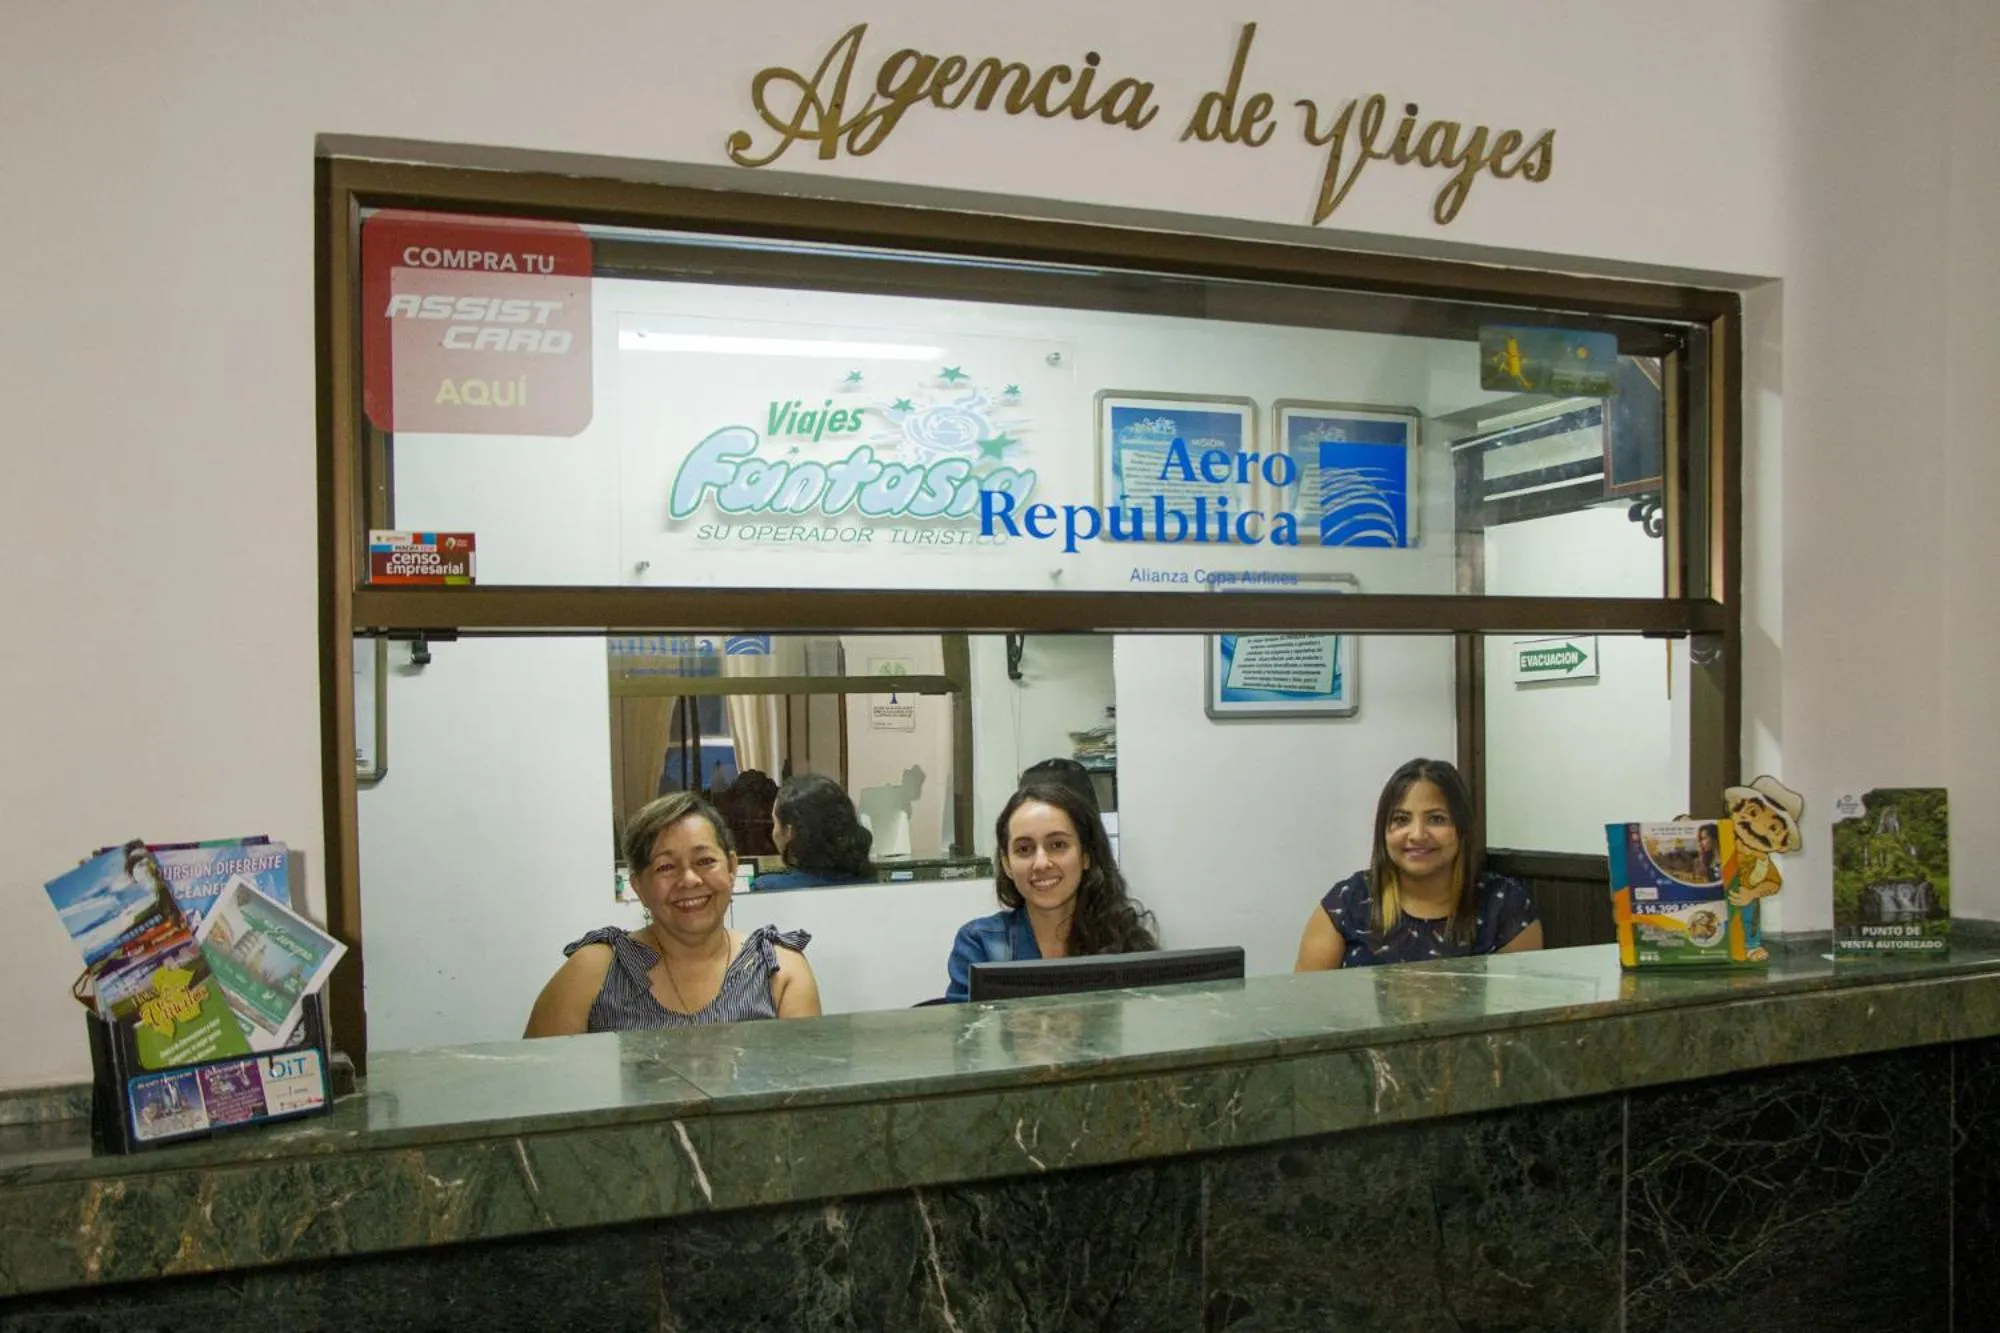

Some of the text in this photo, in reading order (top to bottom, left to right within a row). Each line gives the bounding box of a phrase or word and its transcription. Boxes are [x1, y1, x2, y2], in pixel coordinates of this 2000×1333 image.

[725, 22, 1557, 228] Agencia de Viajes
[403, 246, 555, 274] COMPRA TU
[385, 294, 563, 324] ASSIST
[442, 326, 573, 354] CARD
[435, 375, 528, 407] AQUÍ
[767, 399, 865, 442] Viajes
[1159, 437, 1298, 487] Aero
[697, 524, 731, 541] SU
[738, 525, 875, 543] OPERADOR
[386, 562, 464, 577] Empresarial
[391, 552, 441, 565] censo
[1130, 568, 1298, 586] Alianza Copa Airlines
[163, 862, 212, 881] URSION
[1861, 925, 1922, 937] PUNTO DE
[1840, 940, 1943, 950] VENTA AUTORIZADO
